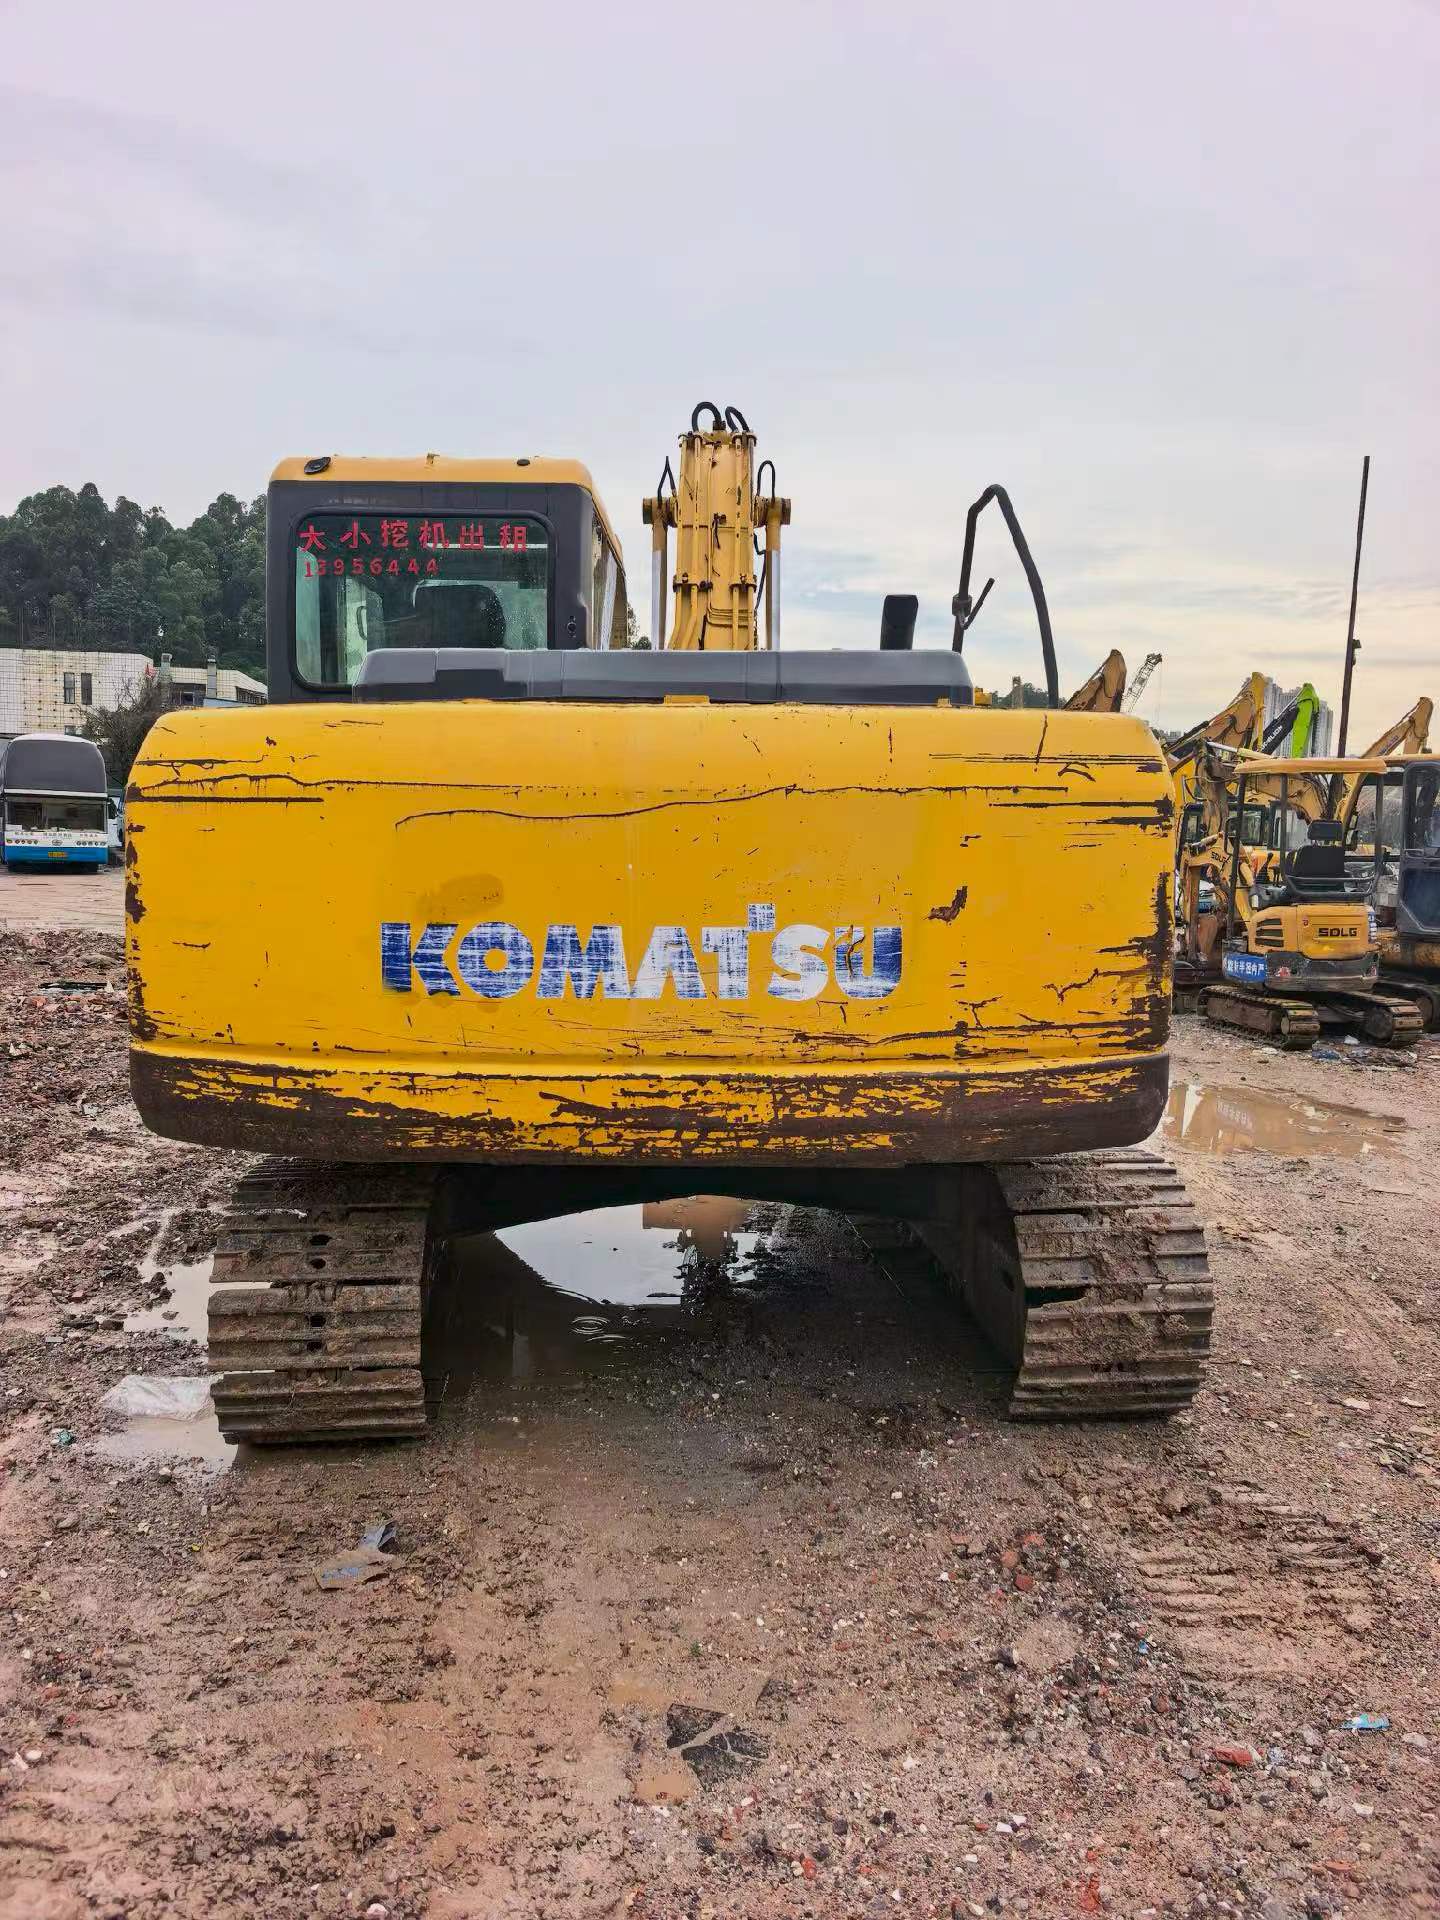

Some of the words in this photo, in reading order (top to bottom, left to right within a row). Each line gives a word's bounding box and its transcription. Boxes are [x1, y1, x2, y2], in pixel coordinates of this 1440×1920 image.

[300, 520, 527, 552] 大小挖机出租
[1318, 927, 1357, 937] SDLG
[381, 904, 902, 1000] KOMATSU
